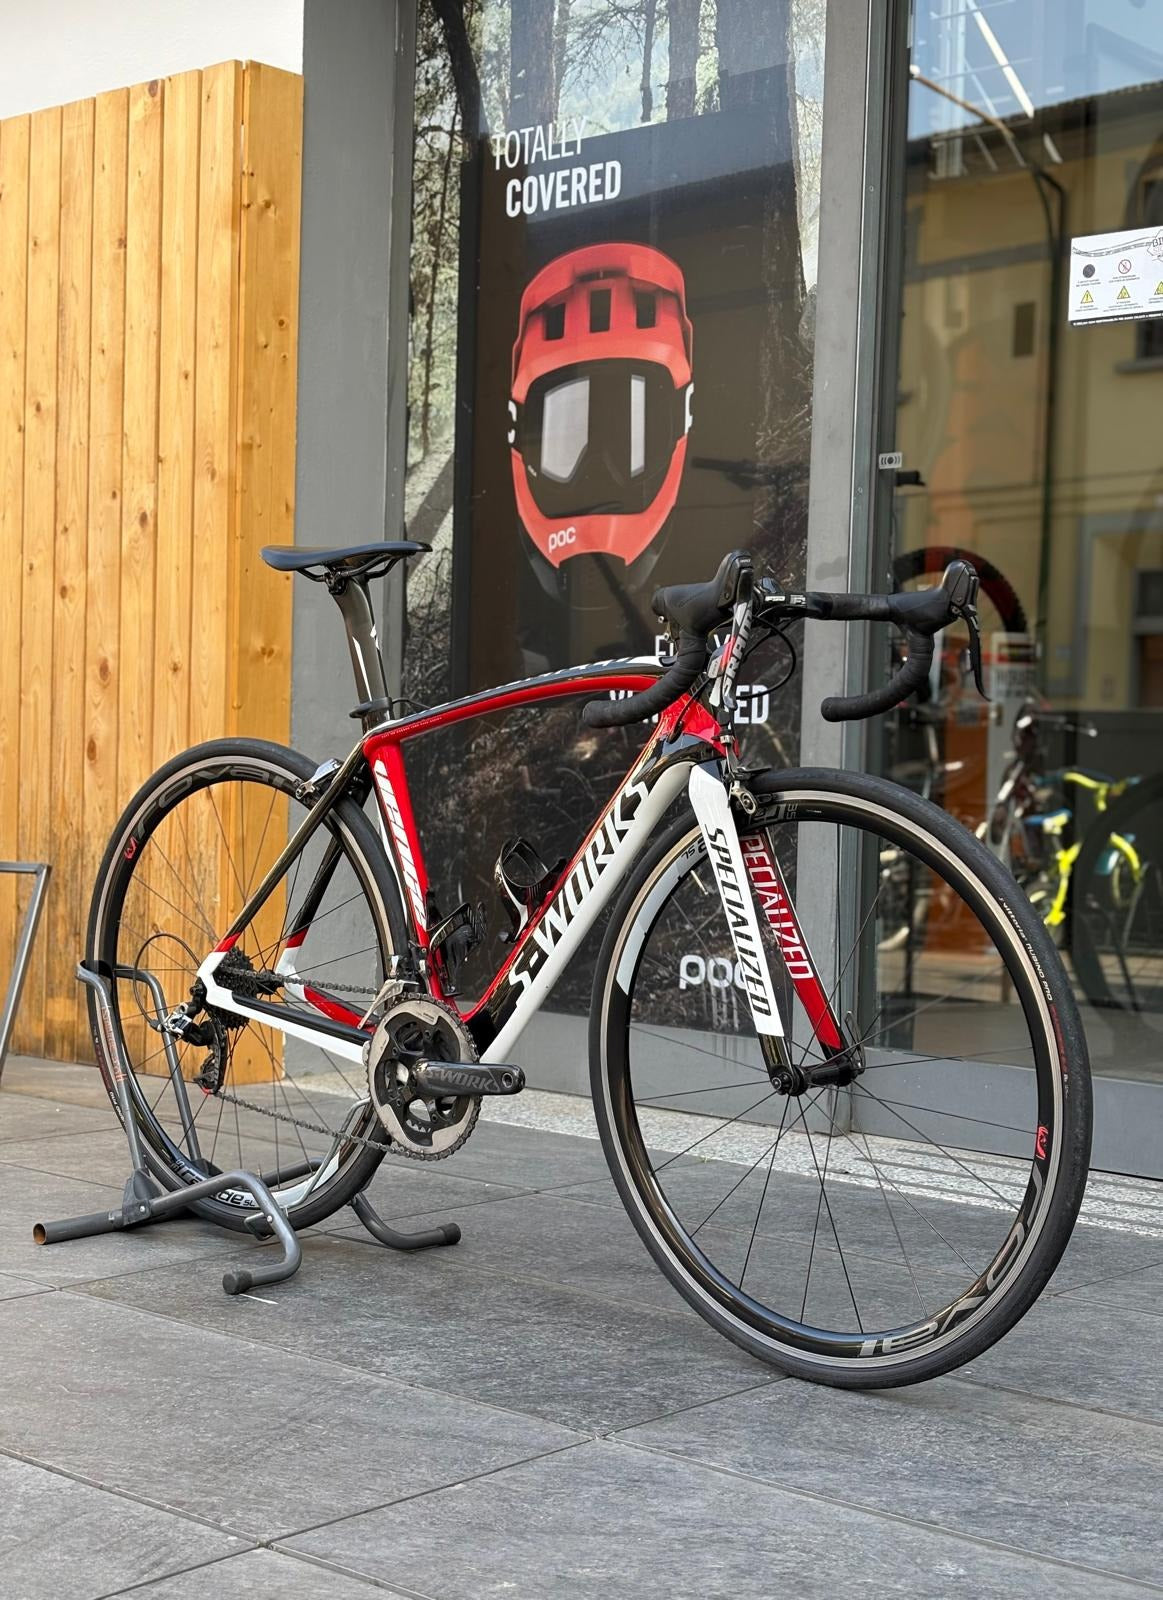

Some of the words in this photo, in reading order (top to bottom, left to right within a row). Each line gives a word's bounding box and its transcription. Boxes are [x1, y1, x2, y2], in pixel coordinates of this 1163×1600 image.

[491, 119, 588, 171] TOTALLY
[505, 160, 622, 218] COVERED
[548, 526, 577, 553] poc
[508, 780, 649, 1006] S-WORKS
[704, 823, 772, 1017] SPECIALIZED
[740, 833, 814, 980] PECIALIZED
[1026, 942, 1045, 979] RUBINO
[1042, 980, 1053, 1001] PRO
